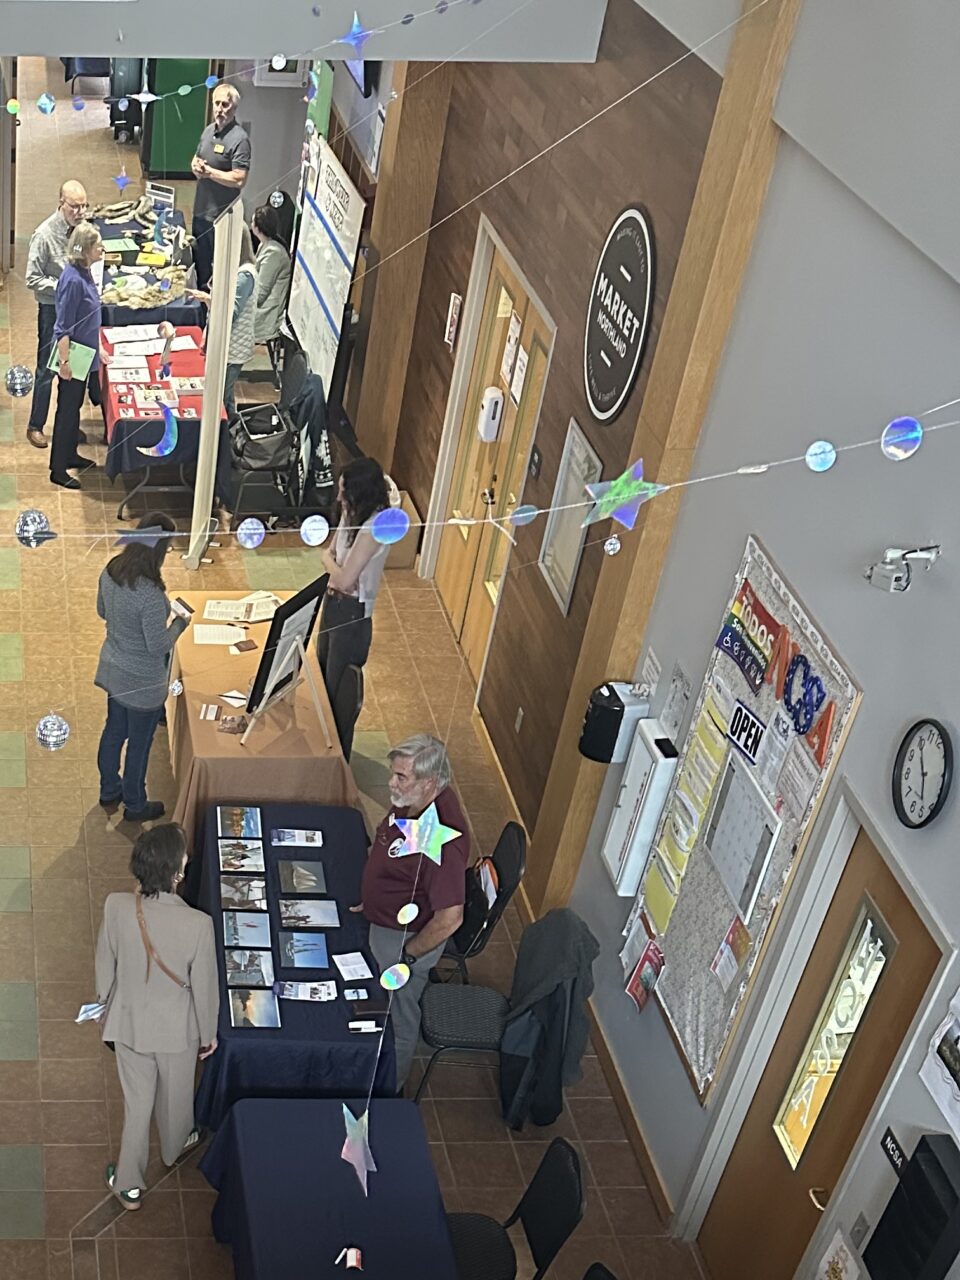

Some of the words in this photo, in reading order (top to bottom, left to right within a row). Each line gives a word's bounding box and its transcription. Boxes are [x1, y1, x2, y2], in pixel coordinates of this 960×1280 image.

[597, 271, 640, 344] MARKET
[596, 308, 627, 359] NORTHLAND
[739, 594, 775, 656] TODOS
[729, 706, 764, 758] OPEN
[926, 729, 936, 745] 11
[907, 749, 915, 762] 9
[904, 767, 911, 780] 8
[905, 786, 912, 798] 7
[909, 801, 917, 813] 6
[918, 805, 925, 818] 5
[884, 1135, 903, 1169] NCSA
